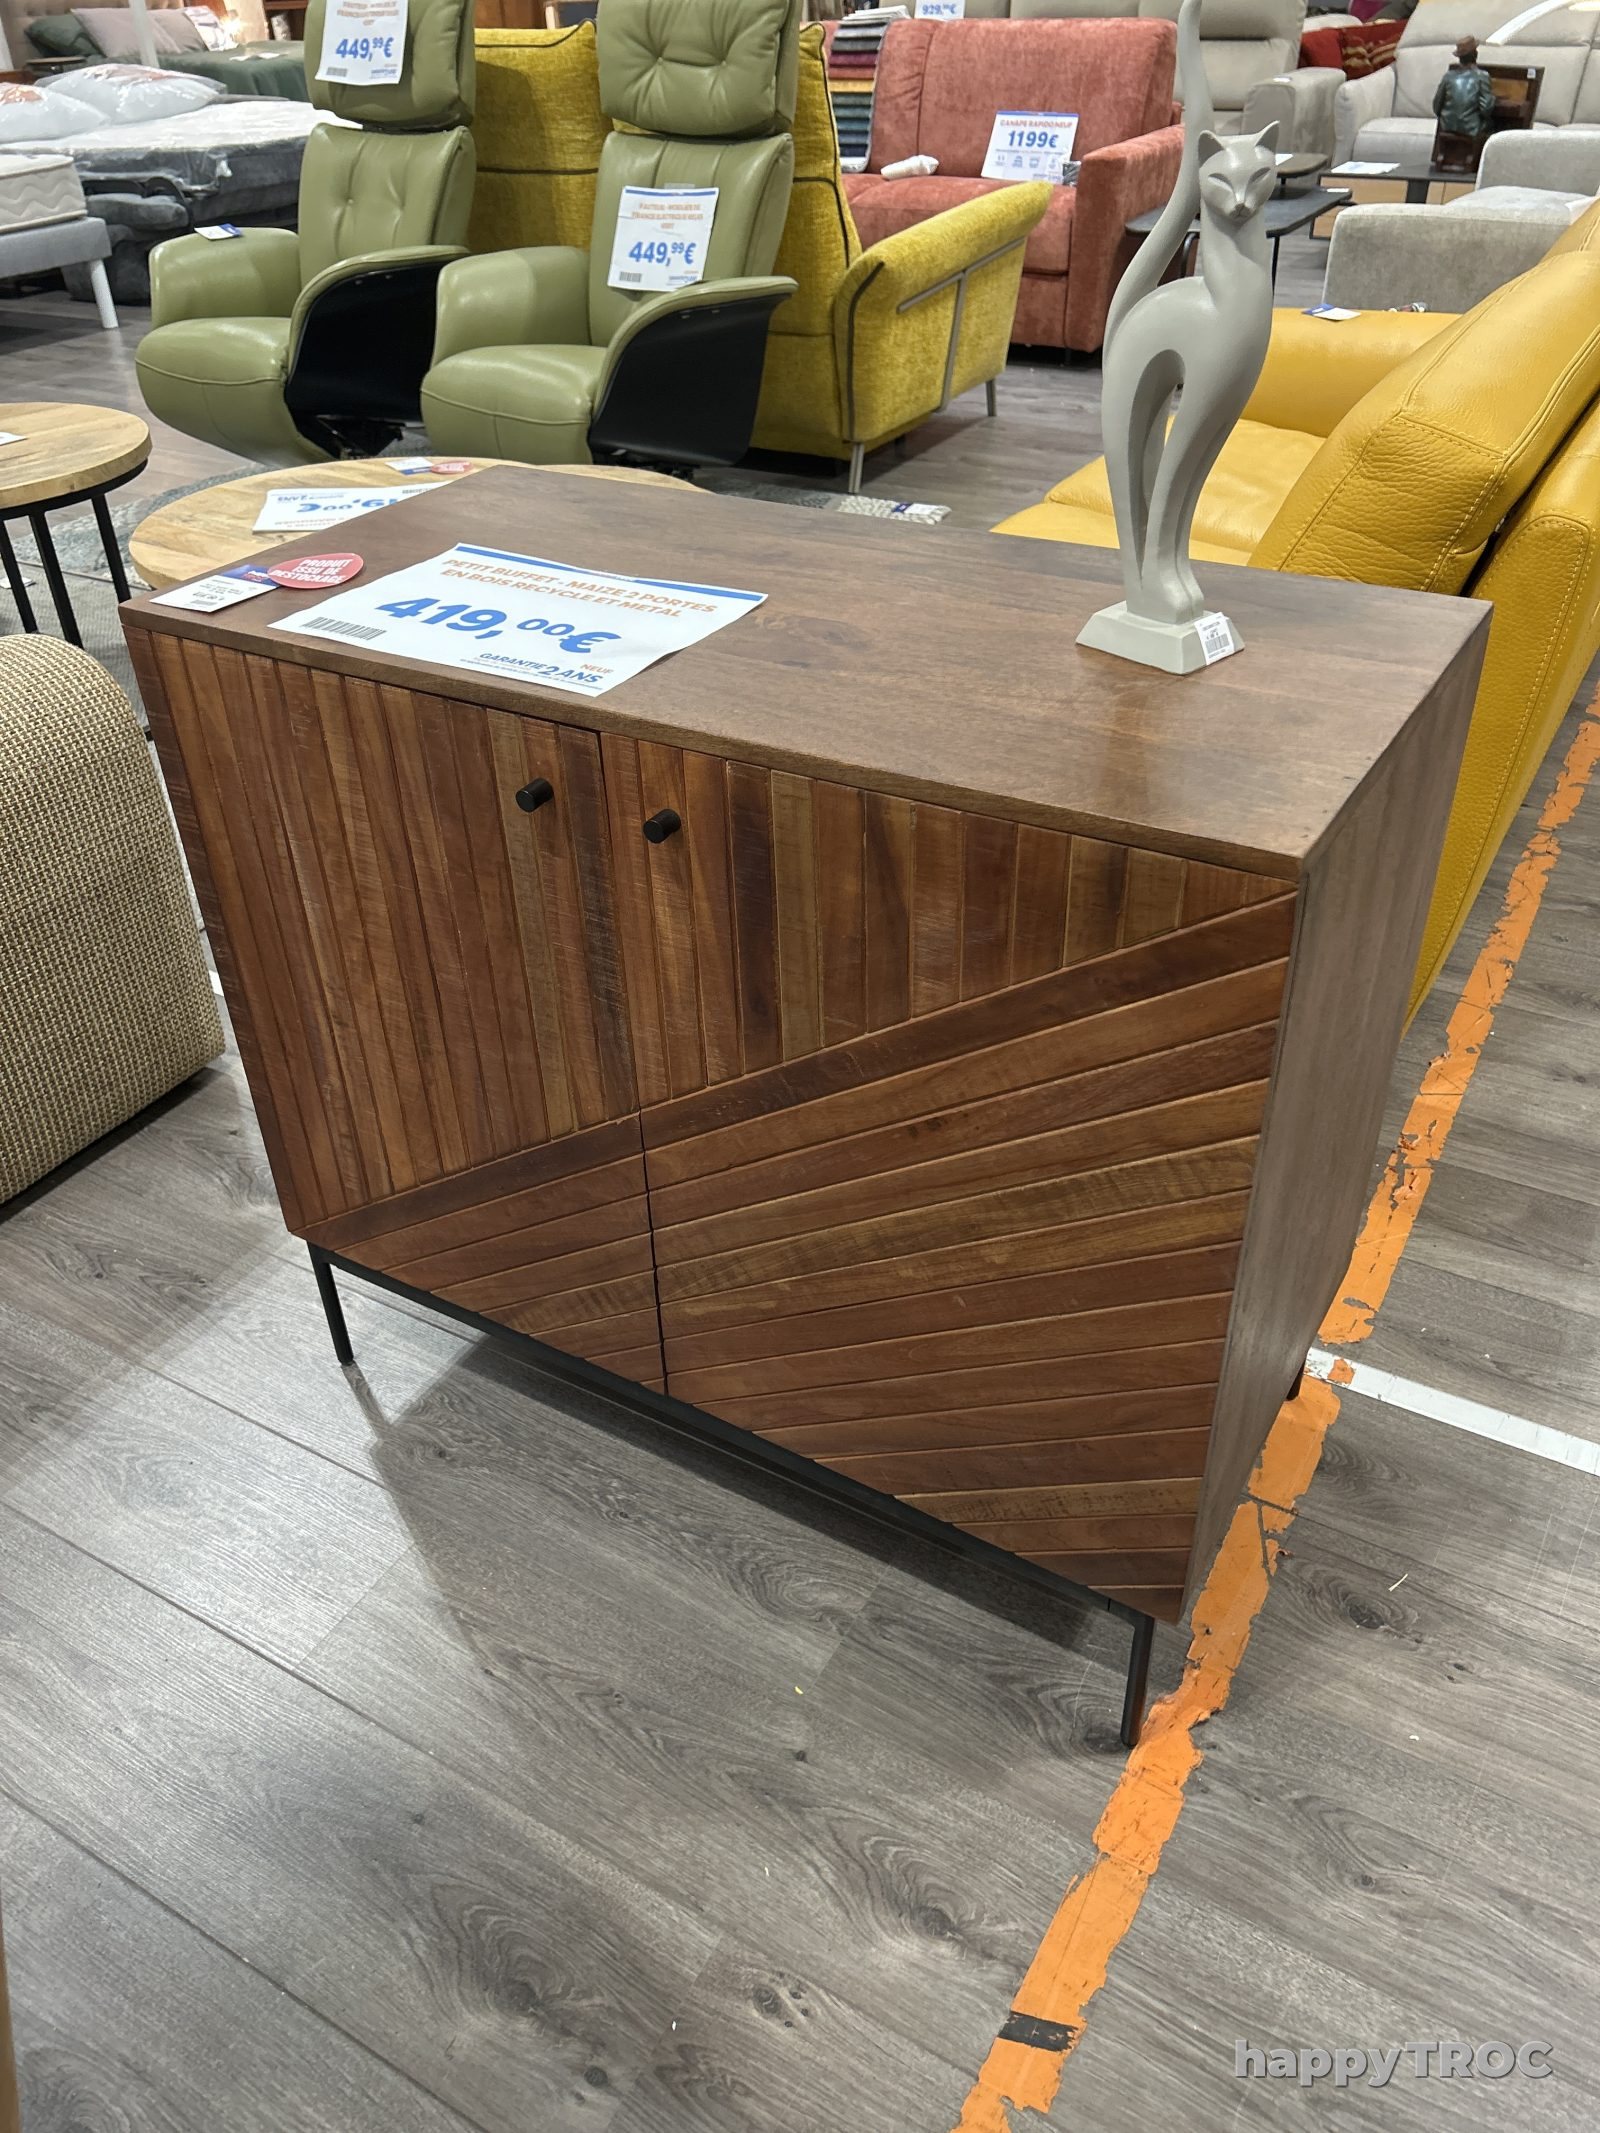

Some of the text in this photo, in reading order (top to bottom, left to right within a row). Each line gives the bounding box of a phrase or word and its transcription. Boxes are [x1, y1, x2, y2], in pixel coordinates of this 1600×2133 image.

[336, 37, 394, 61] 449,99€
[1008, 130, 1059, 148] 1199€
[629, 242, 696, 266] 449,99€
[291, 566, 343, 575] ISSU DE
[299, 559, 353, 567] PRODUIT
[268, 569, 346, 584] DESTOCKAGE
[442, 559, 495, 570] PETIT
[491, 568, 560, 584] BUFFET
[565, 580, 627, 597] MAIZE
[624, 591, 640, 599] 2
[638, 594, 718, 612] PORTES
[440, 569, 682, 617] EN BOIS RECYCLE ET METAL
[374, 597, 622, 654] 419,00€
[479, 653, 548, 670] GARANTIE
[538, 665, 560, 676] 2
[556, 669, 604, 683] ANS
[580, 664, 614, 674] NEUF
